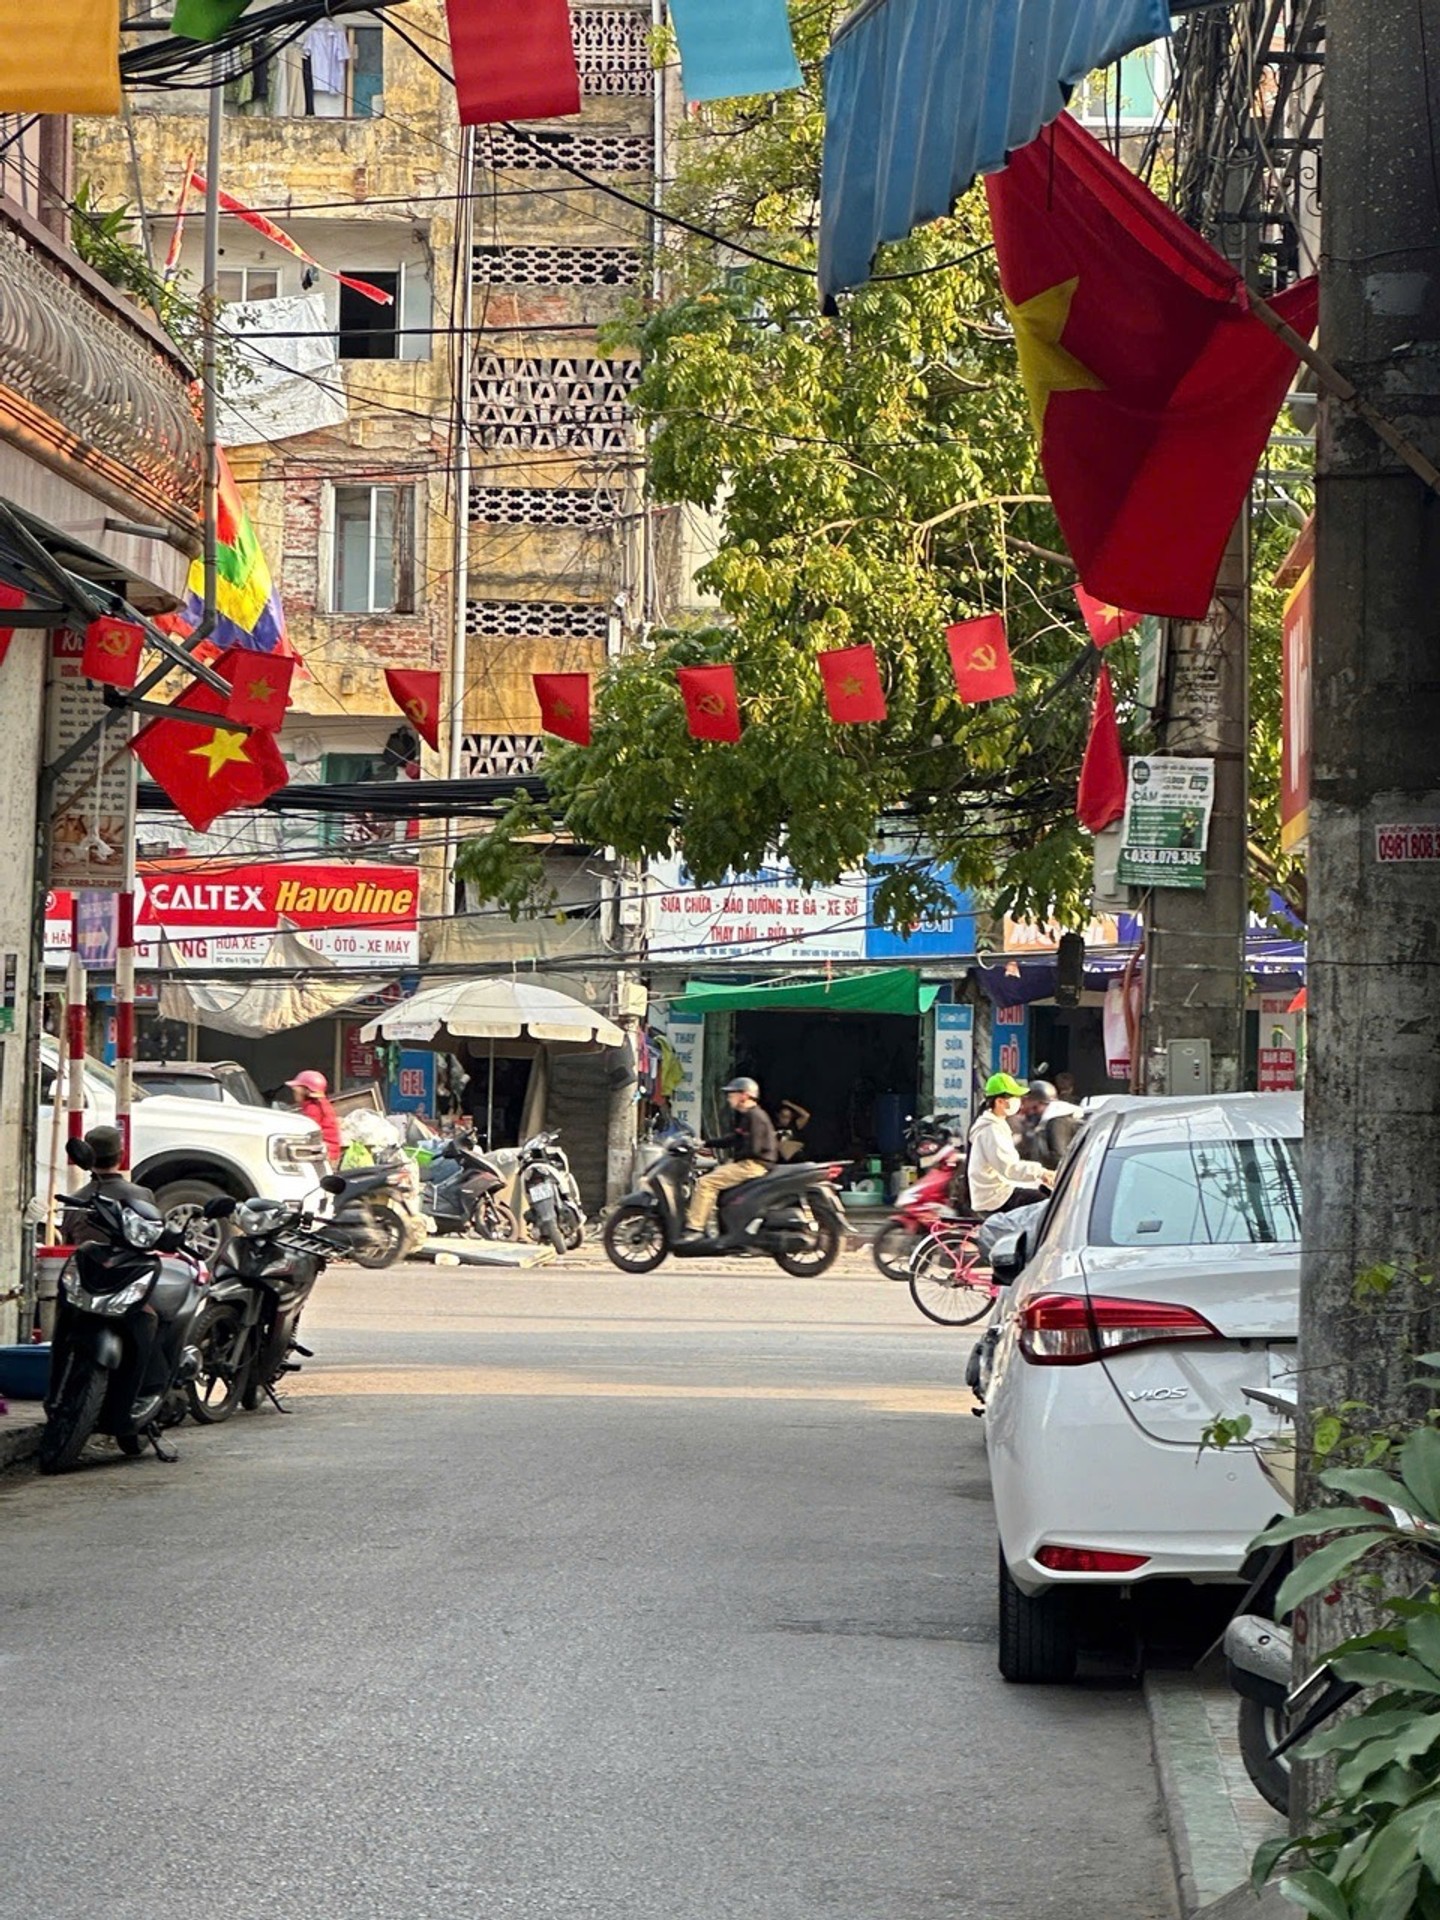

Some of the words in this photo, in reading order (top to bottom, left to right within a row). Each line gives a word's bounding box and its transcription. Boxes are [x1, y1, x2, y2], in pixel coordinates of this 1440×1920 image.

[149, 884, 267, 911] CALTEX
[274, 880, 414, 915] Havoline
[786, 899, 799, 915] XE
[827, 899, 840, 915] XE
[367, 940, 382, 953] XE
[385, 936, 411, 953] MÁY
[1126, 1387, 1189, 1402] VIOS
